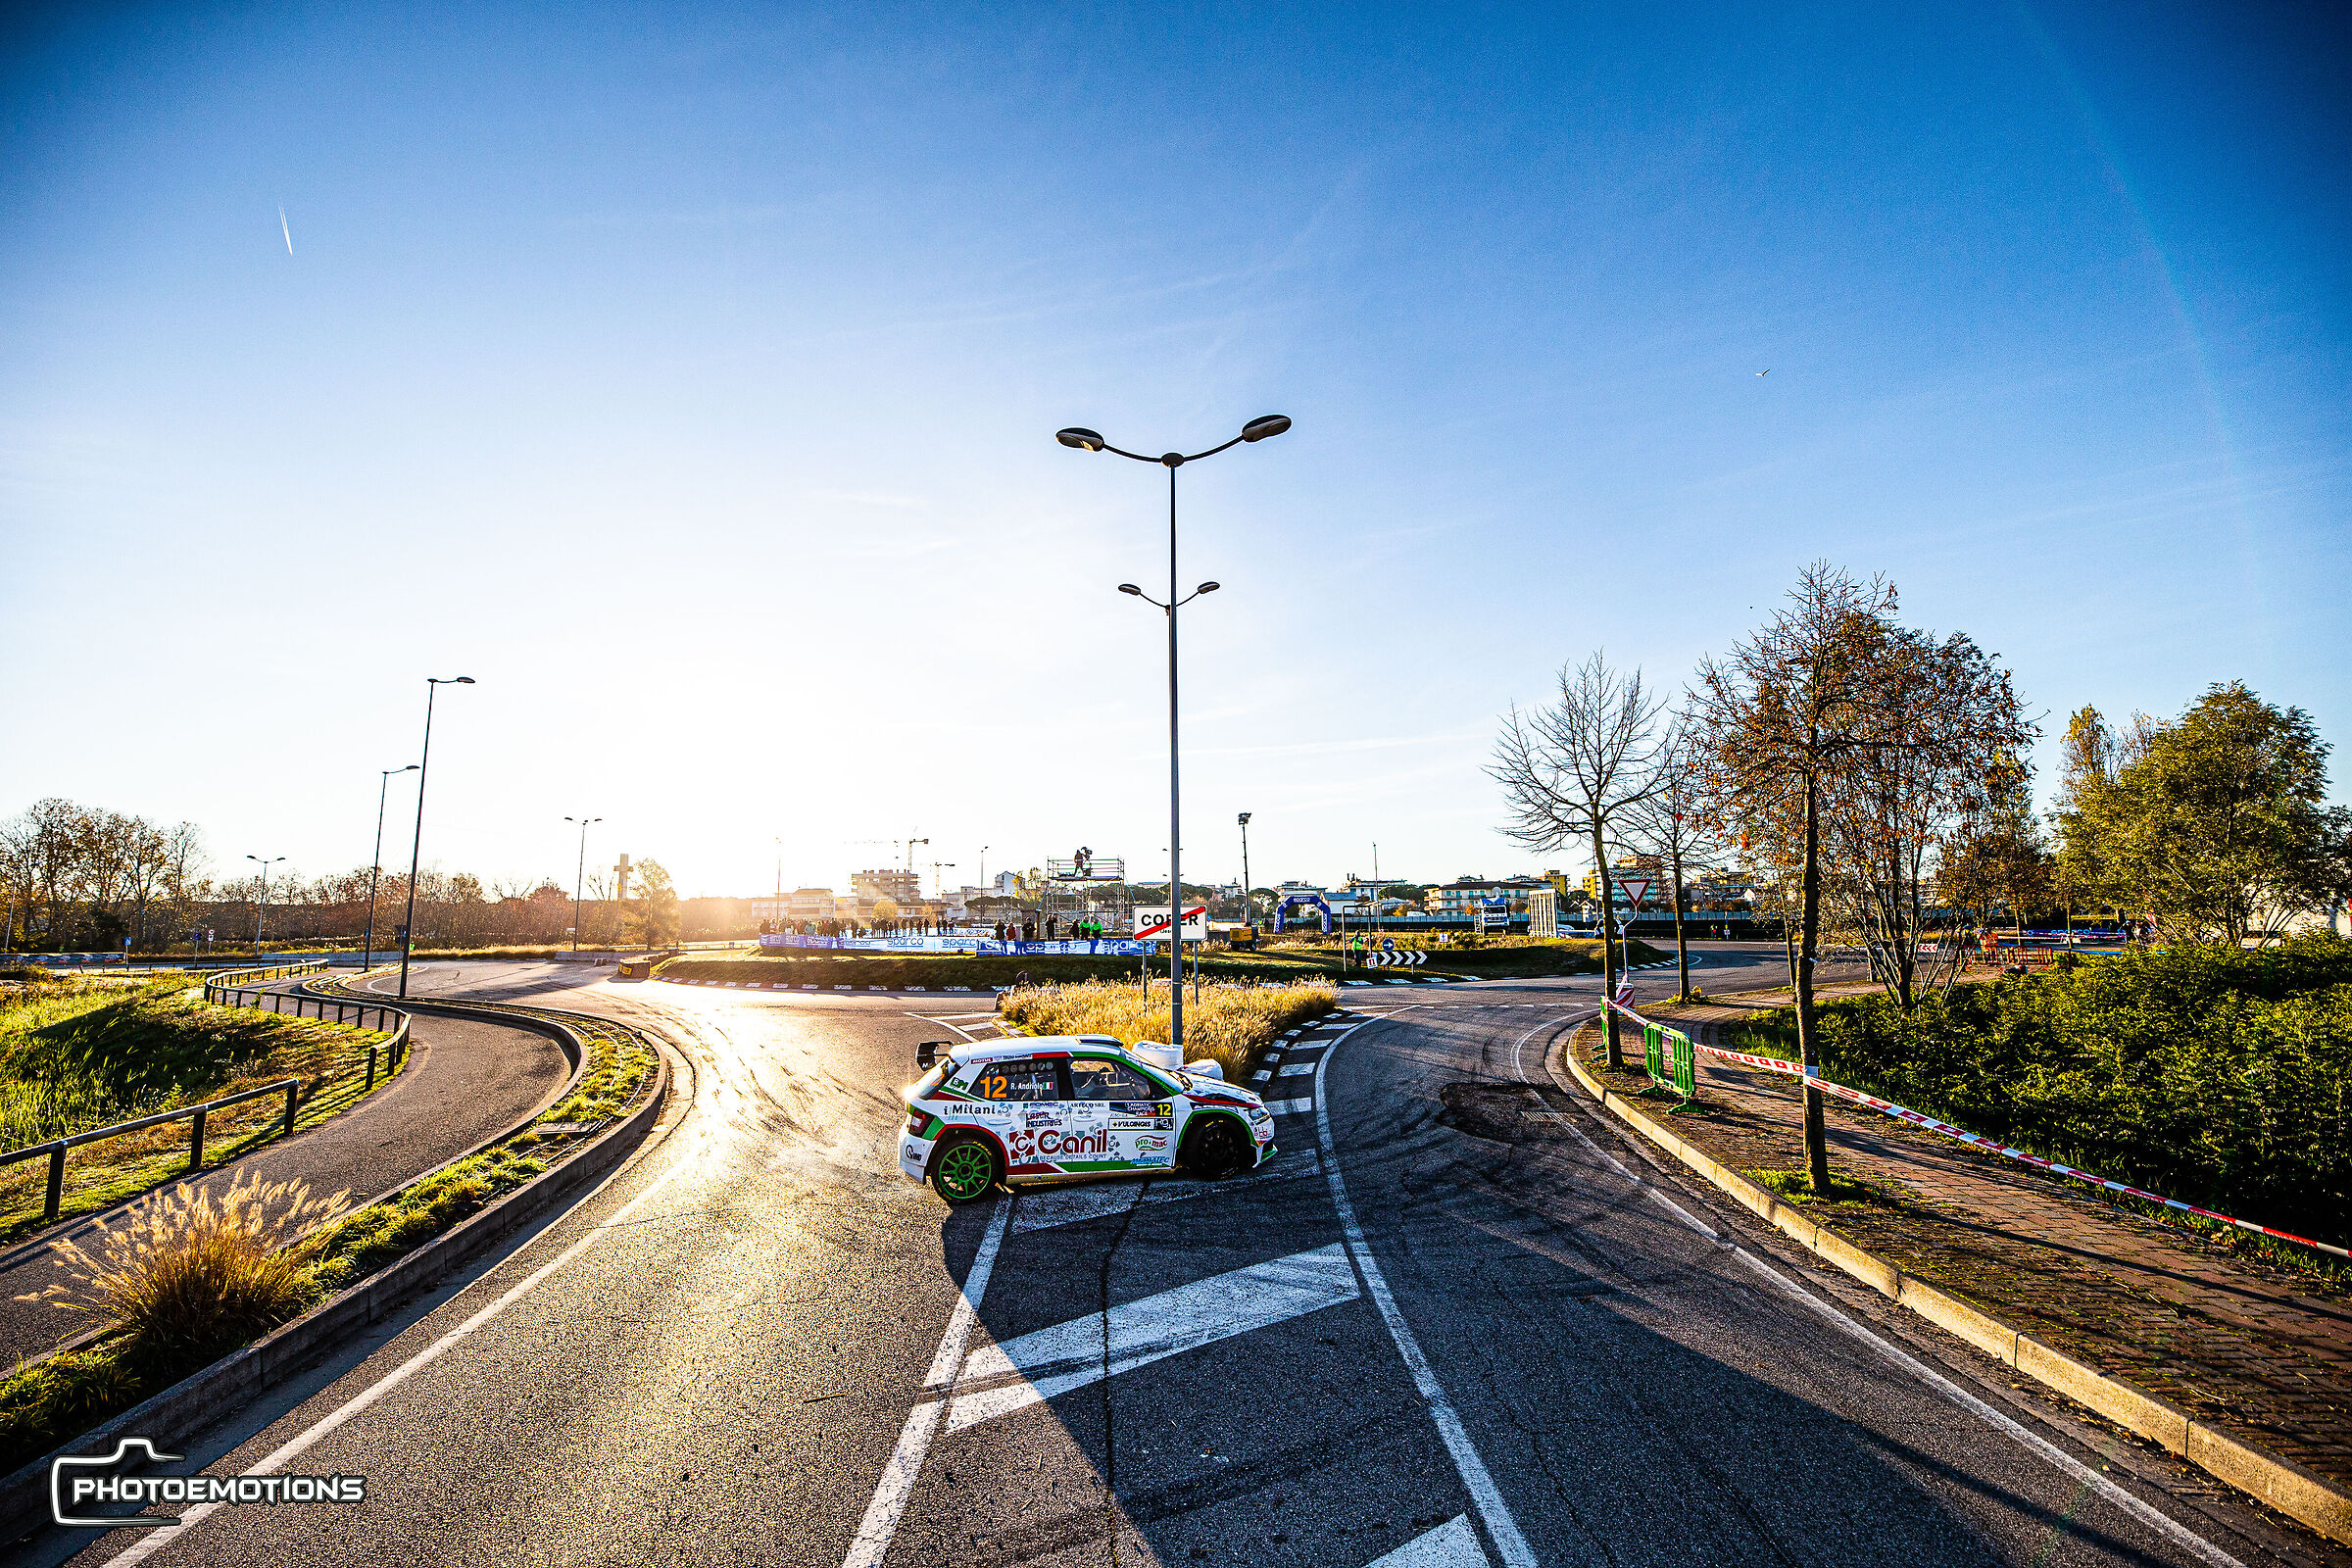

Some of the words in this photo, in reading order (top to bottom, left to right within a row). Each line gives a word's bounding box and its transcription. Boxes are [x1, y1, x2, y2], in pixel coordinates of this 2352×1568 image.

[887, 937, 924, 948] sparco
[980, 1075, 1007, 1098] 12
[1018, 1082, 1044, 1091] Andriolo
[952, 1104, 996, 1115] Milani
[1156, 1103, 1171, 1115] 12
[1038, 1129, 1107, 1154] Canil
